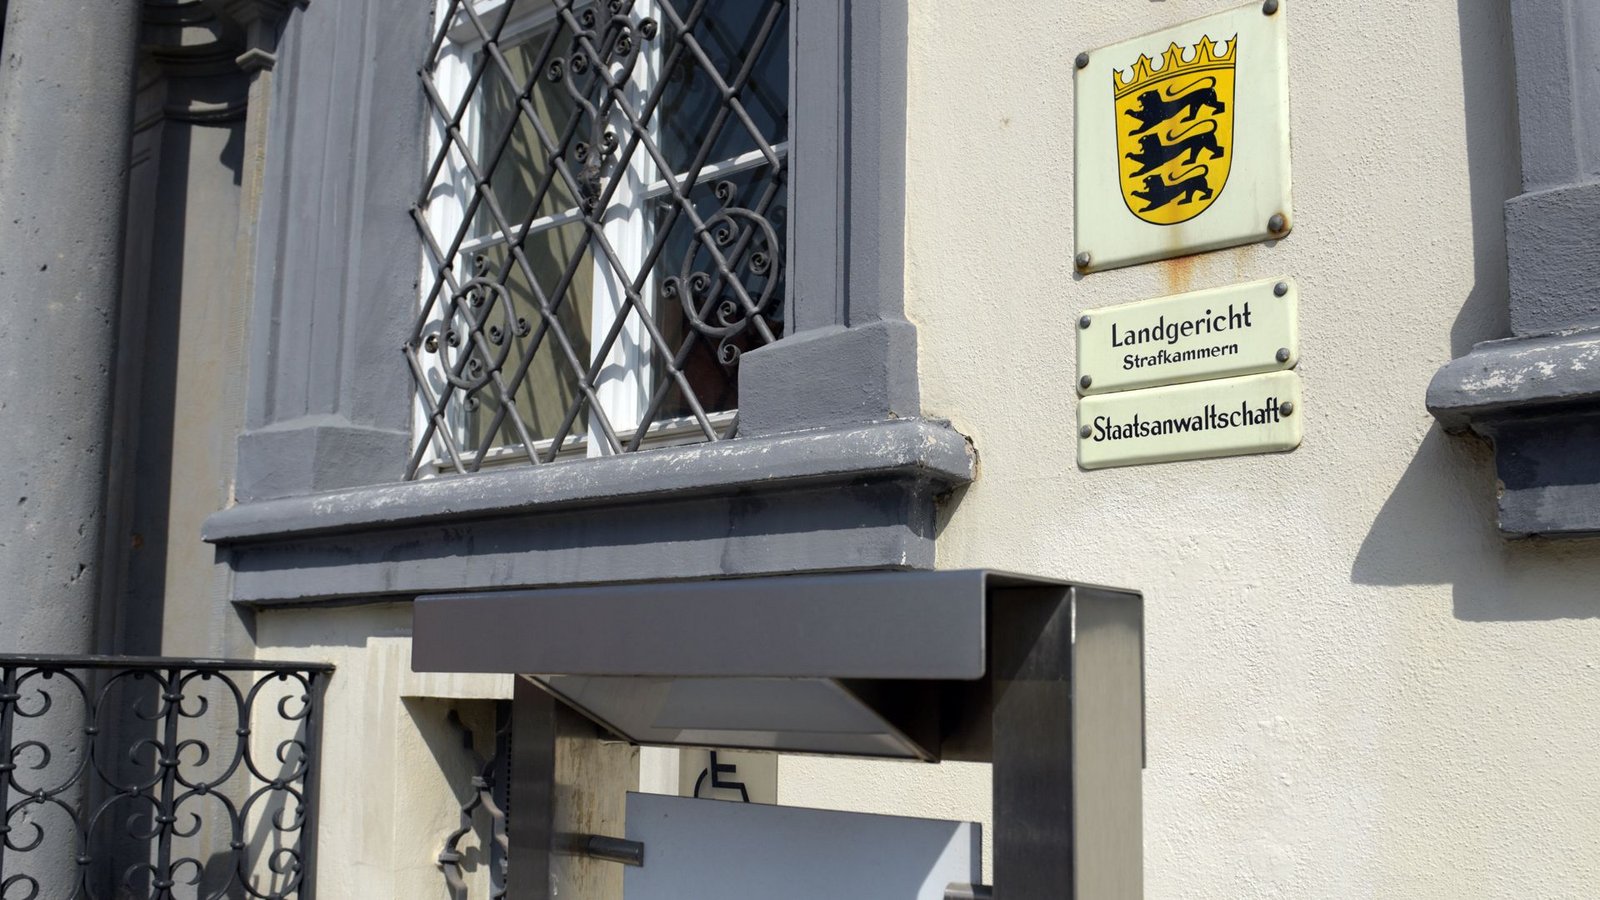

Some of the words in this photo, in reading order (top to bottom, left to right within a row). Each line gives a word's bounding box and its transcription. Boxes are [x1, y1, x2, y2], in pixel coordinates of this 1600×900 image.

[1112, 302, 1252, 348] Landgericht
[1122, 343, 1239, 370] Strafkammern
[1093, 397, 1280, 442] Staatsanwaltschaft
